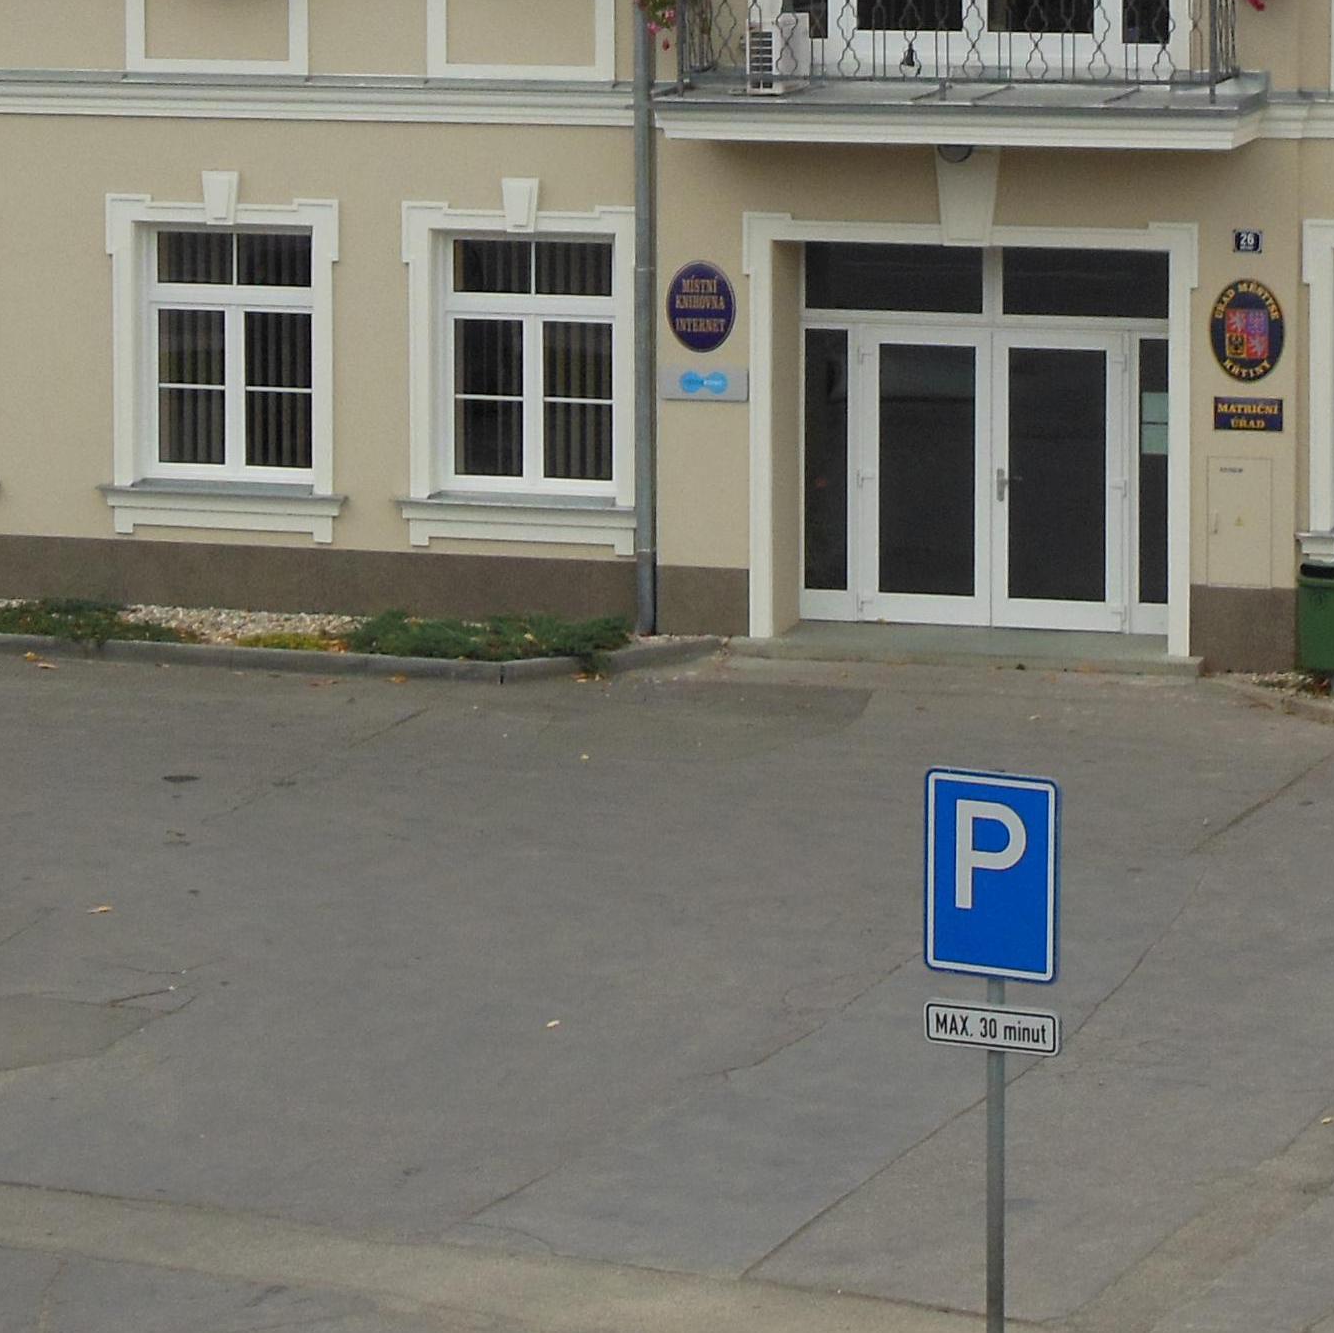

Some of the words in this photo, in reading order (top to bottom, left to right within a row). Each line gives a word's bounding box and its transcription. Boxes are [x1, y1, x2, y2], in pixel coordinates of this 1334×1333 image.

[1239, 232, 1255, 245] 26
[682, 275, 718, 293] MÍSTNÍ
[675, 295, 726, 310] KNIHOVNA
[675, 318, 727, 333] INTERNET
[1217, 401, 1279, 415] MATRIČNÍ
[1230, 415, 1266, 429] ÚŘAD
[954, 798, 1028, 910] P
[934, 1012, 974, 1038] MAX.
[979, 1017, 999, 1040] 30
[1003, 1021, 1048, 1045] minut
